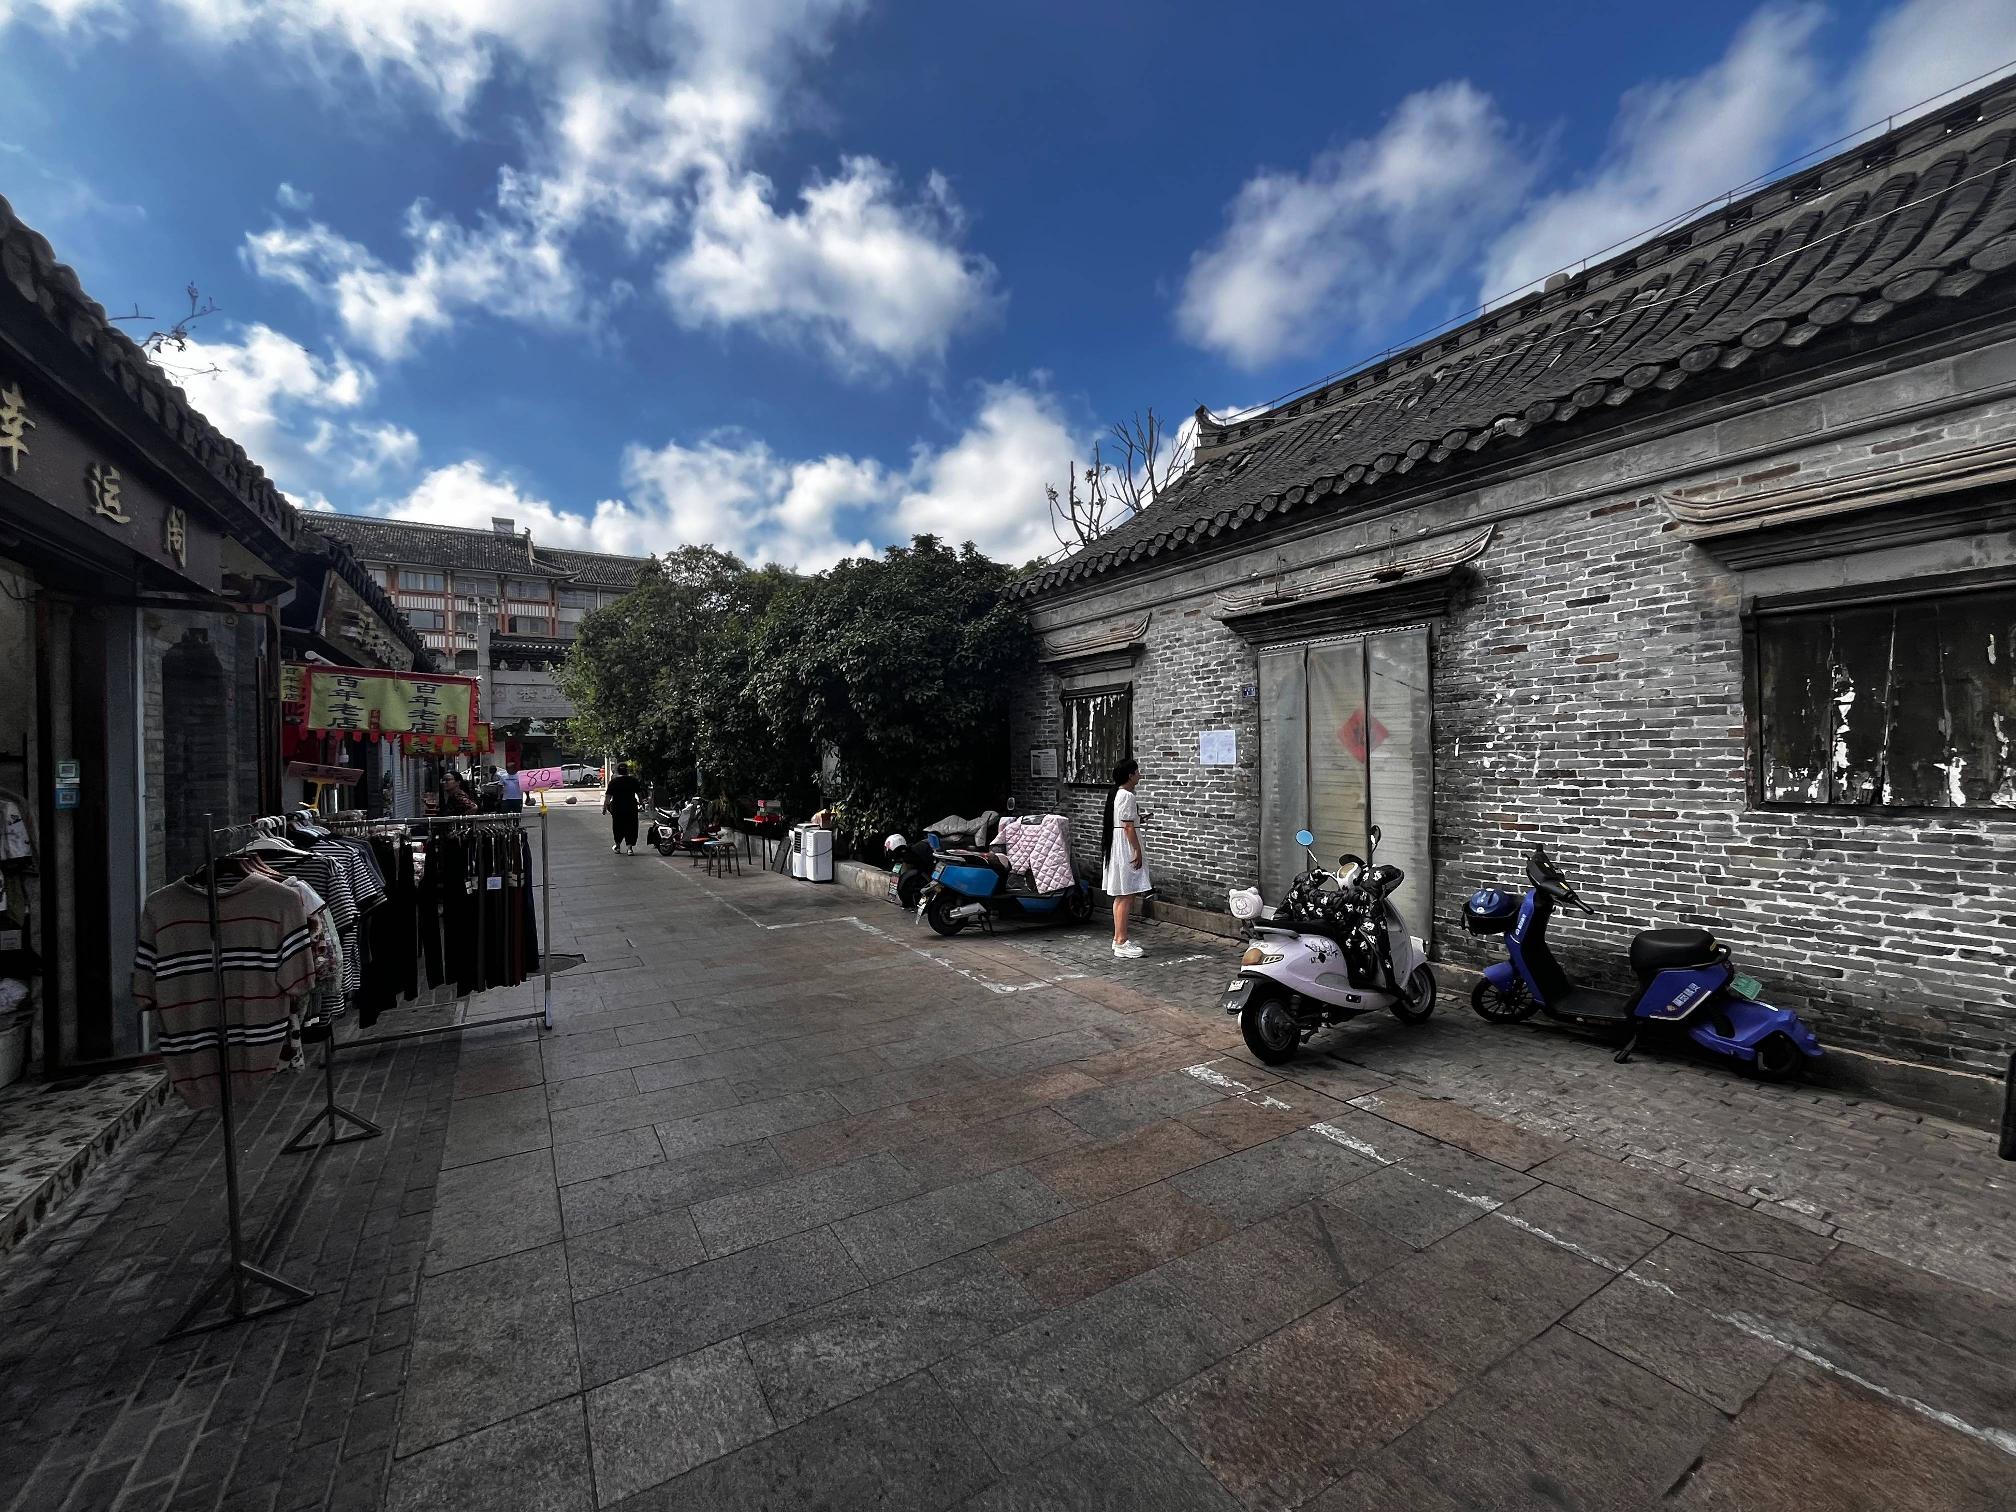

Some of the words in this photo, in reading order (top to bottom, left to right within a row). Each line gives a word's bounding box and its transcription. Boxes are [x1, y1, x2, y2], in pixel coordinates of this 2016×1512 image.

[328, 676, 365, 728] 百年老店
[407, 682, 443, 734] 百年老店
[526, 769, 560, 789] 80元
